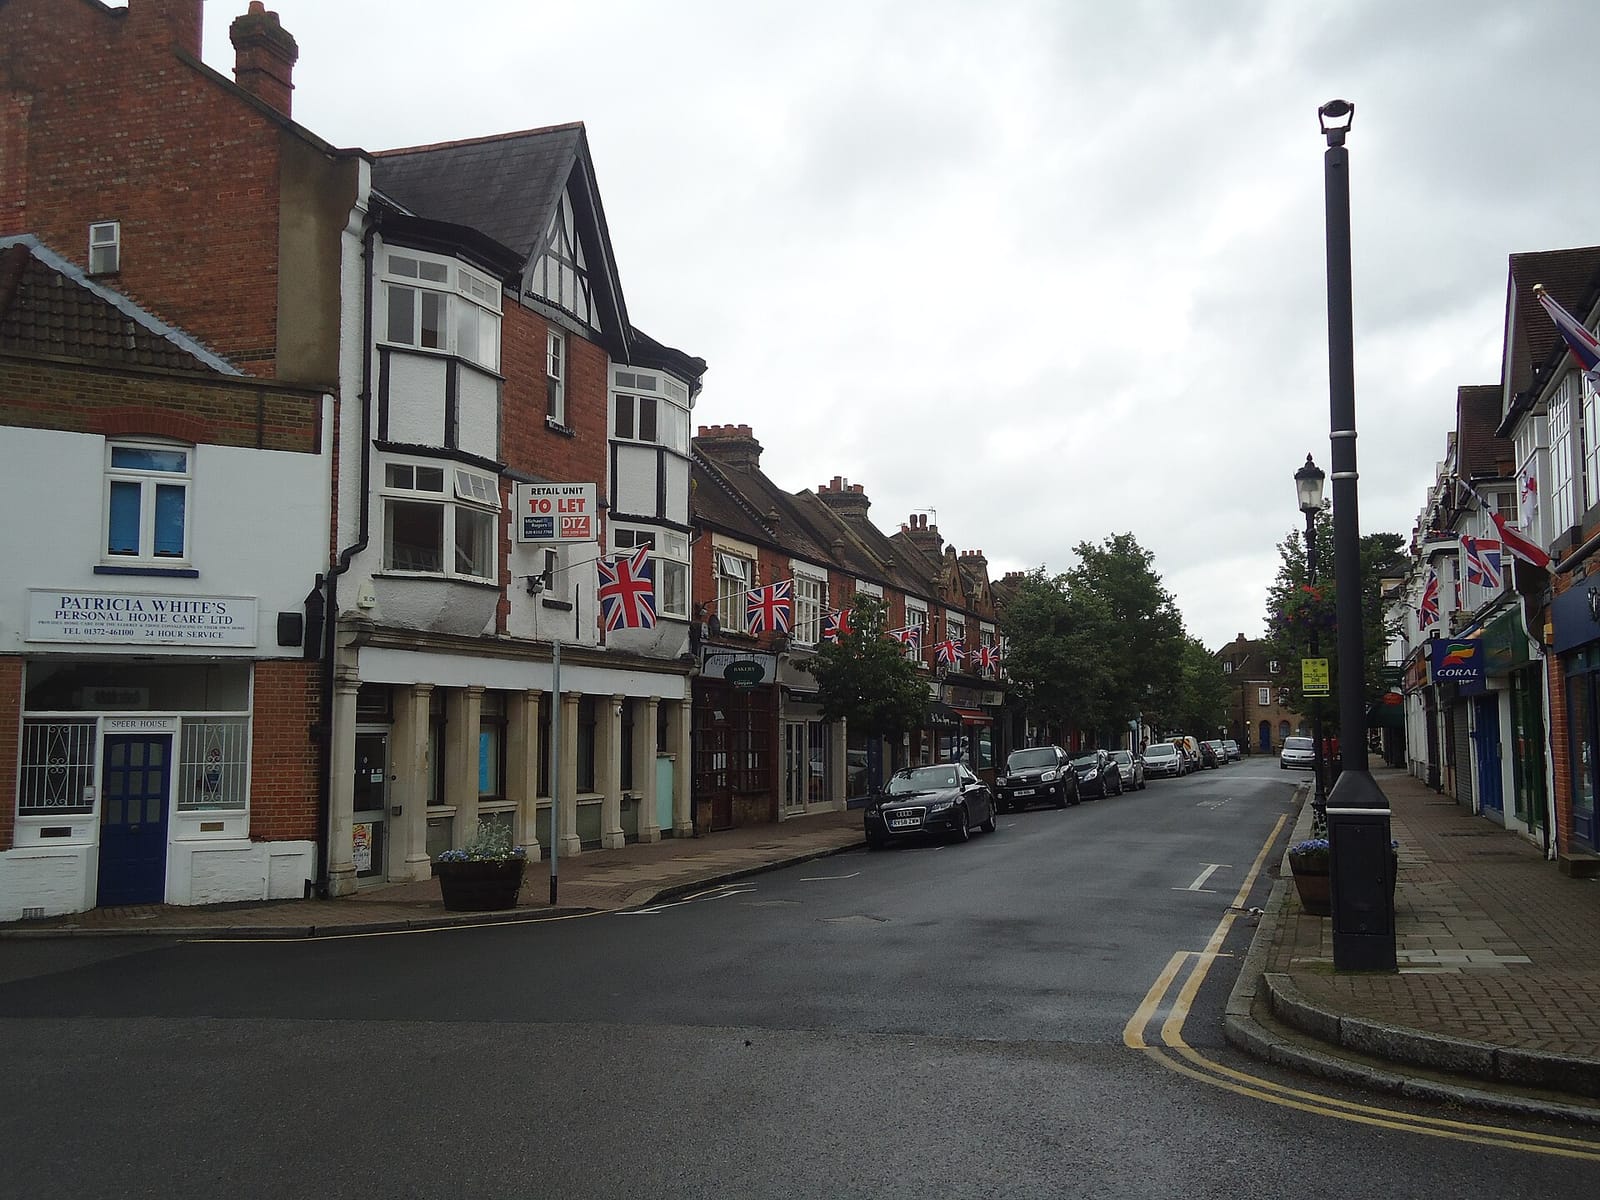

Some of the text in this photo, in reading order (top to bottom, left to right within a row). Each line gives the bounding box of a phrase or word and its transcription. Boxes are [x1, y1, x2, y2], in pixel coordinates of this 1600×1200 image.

[531, 487, 584, 495] RETAIL UNIT
[528, 498, 586, 514] TO LET
[562, 517, 586, 529] DTZ
[61, 597, 226, 614] PATRICIA WHITE'S
[55, 611, 233, 625] PERSONAL HOME CARE LTD
[64, 627, 80, 635] TEL
[84, 628, 134, 636] 01372-461100
[158, 630, 184, 638] HOUR
[187, 631, 224, 639] SERVICE
[1437, 668, 1479, 677] CORAL
[111, 720, 168, 728] SPEER HOUSE
